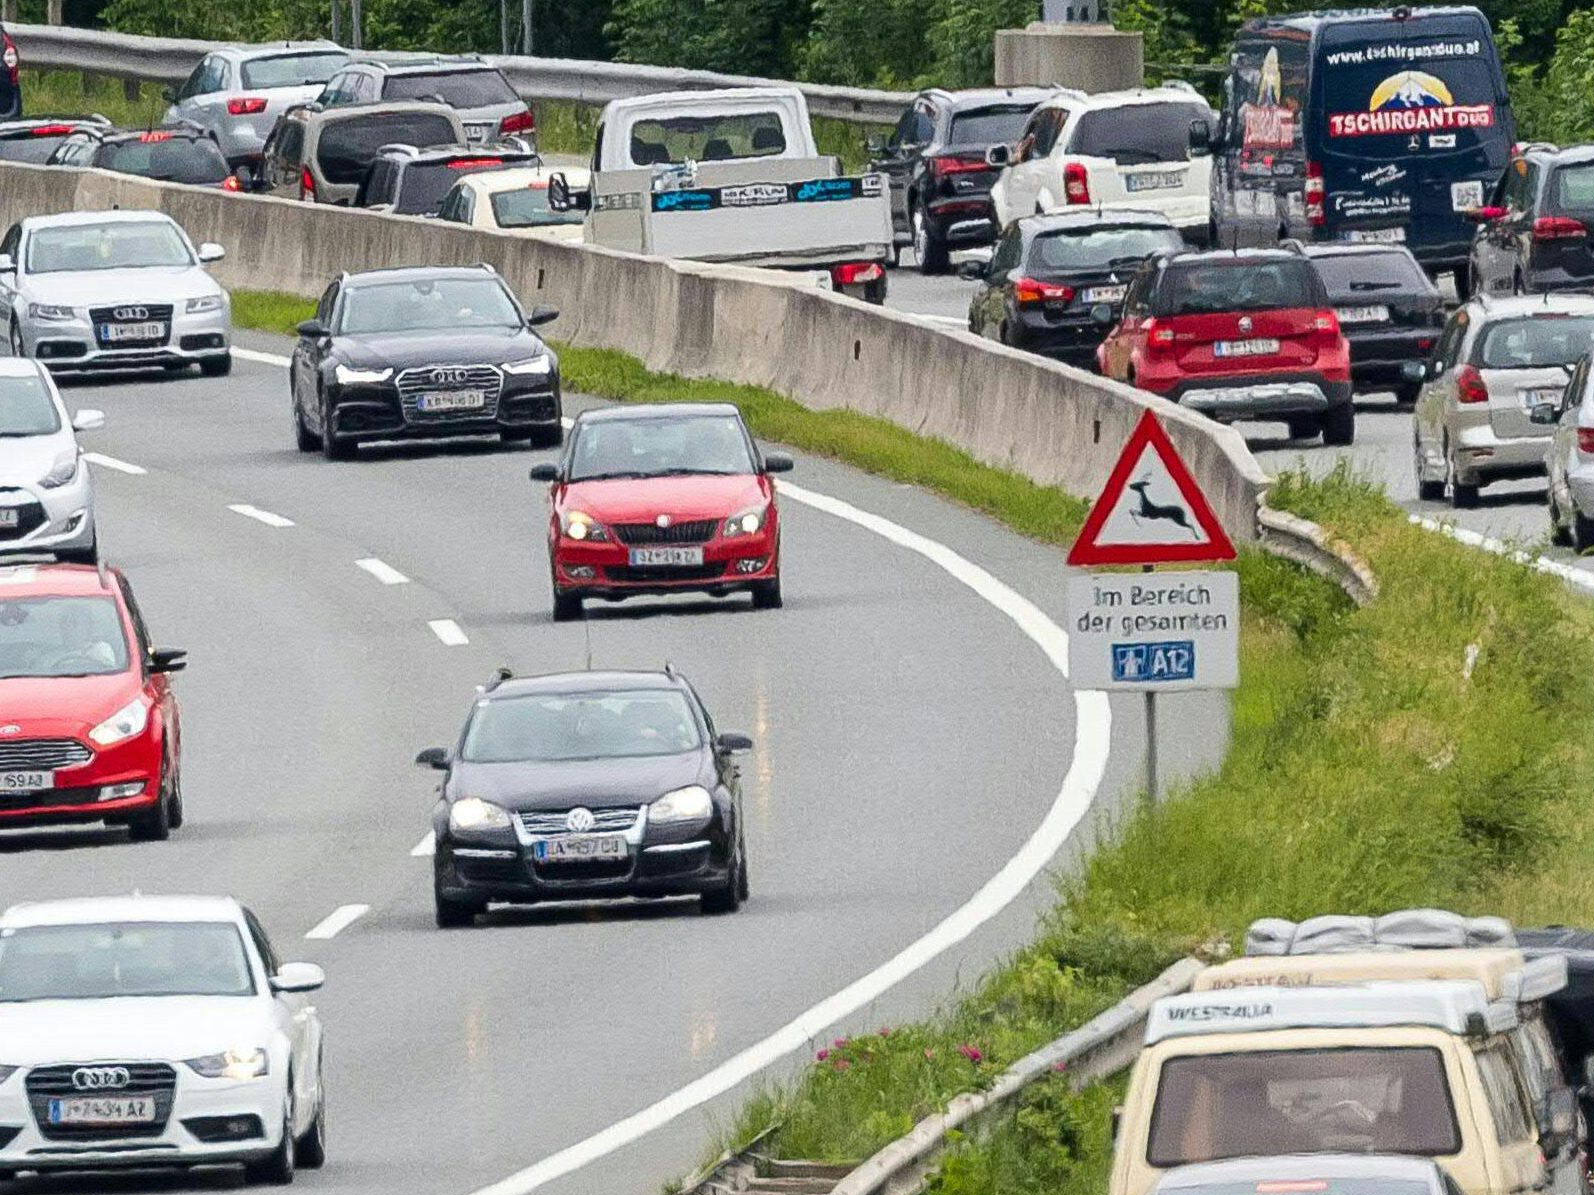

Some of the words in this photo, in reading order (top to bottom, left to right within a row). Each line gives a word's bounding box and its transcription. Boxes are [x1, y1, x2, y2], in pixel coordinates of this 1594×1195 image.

[1093, 585, 1123, 607] Im
[1130, 583, 1211, 606] Bereich
[1077, 611, 1114, 633] der
[1121, 613, 1228, 637] gesamten
[1152, 648, 1190, 676] A12
